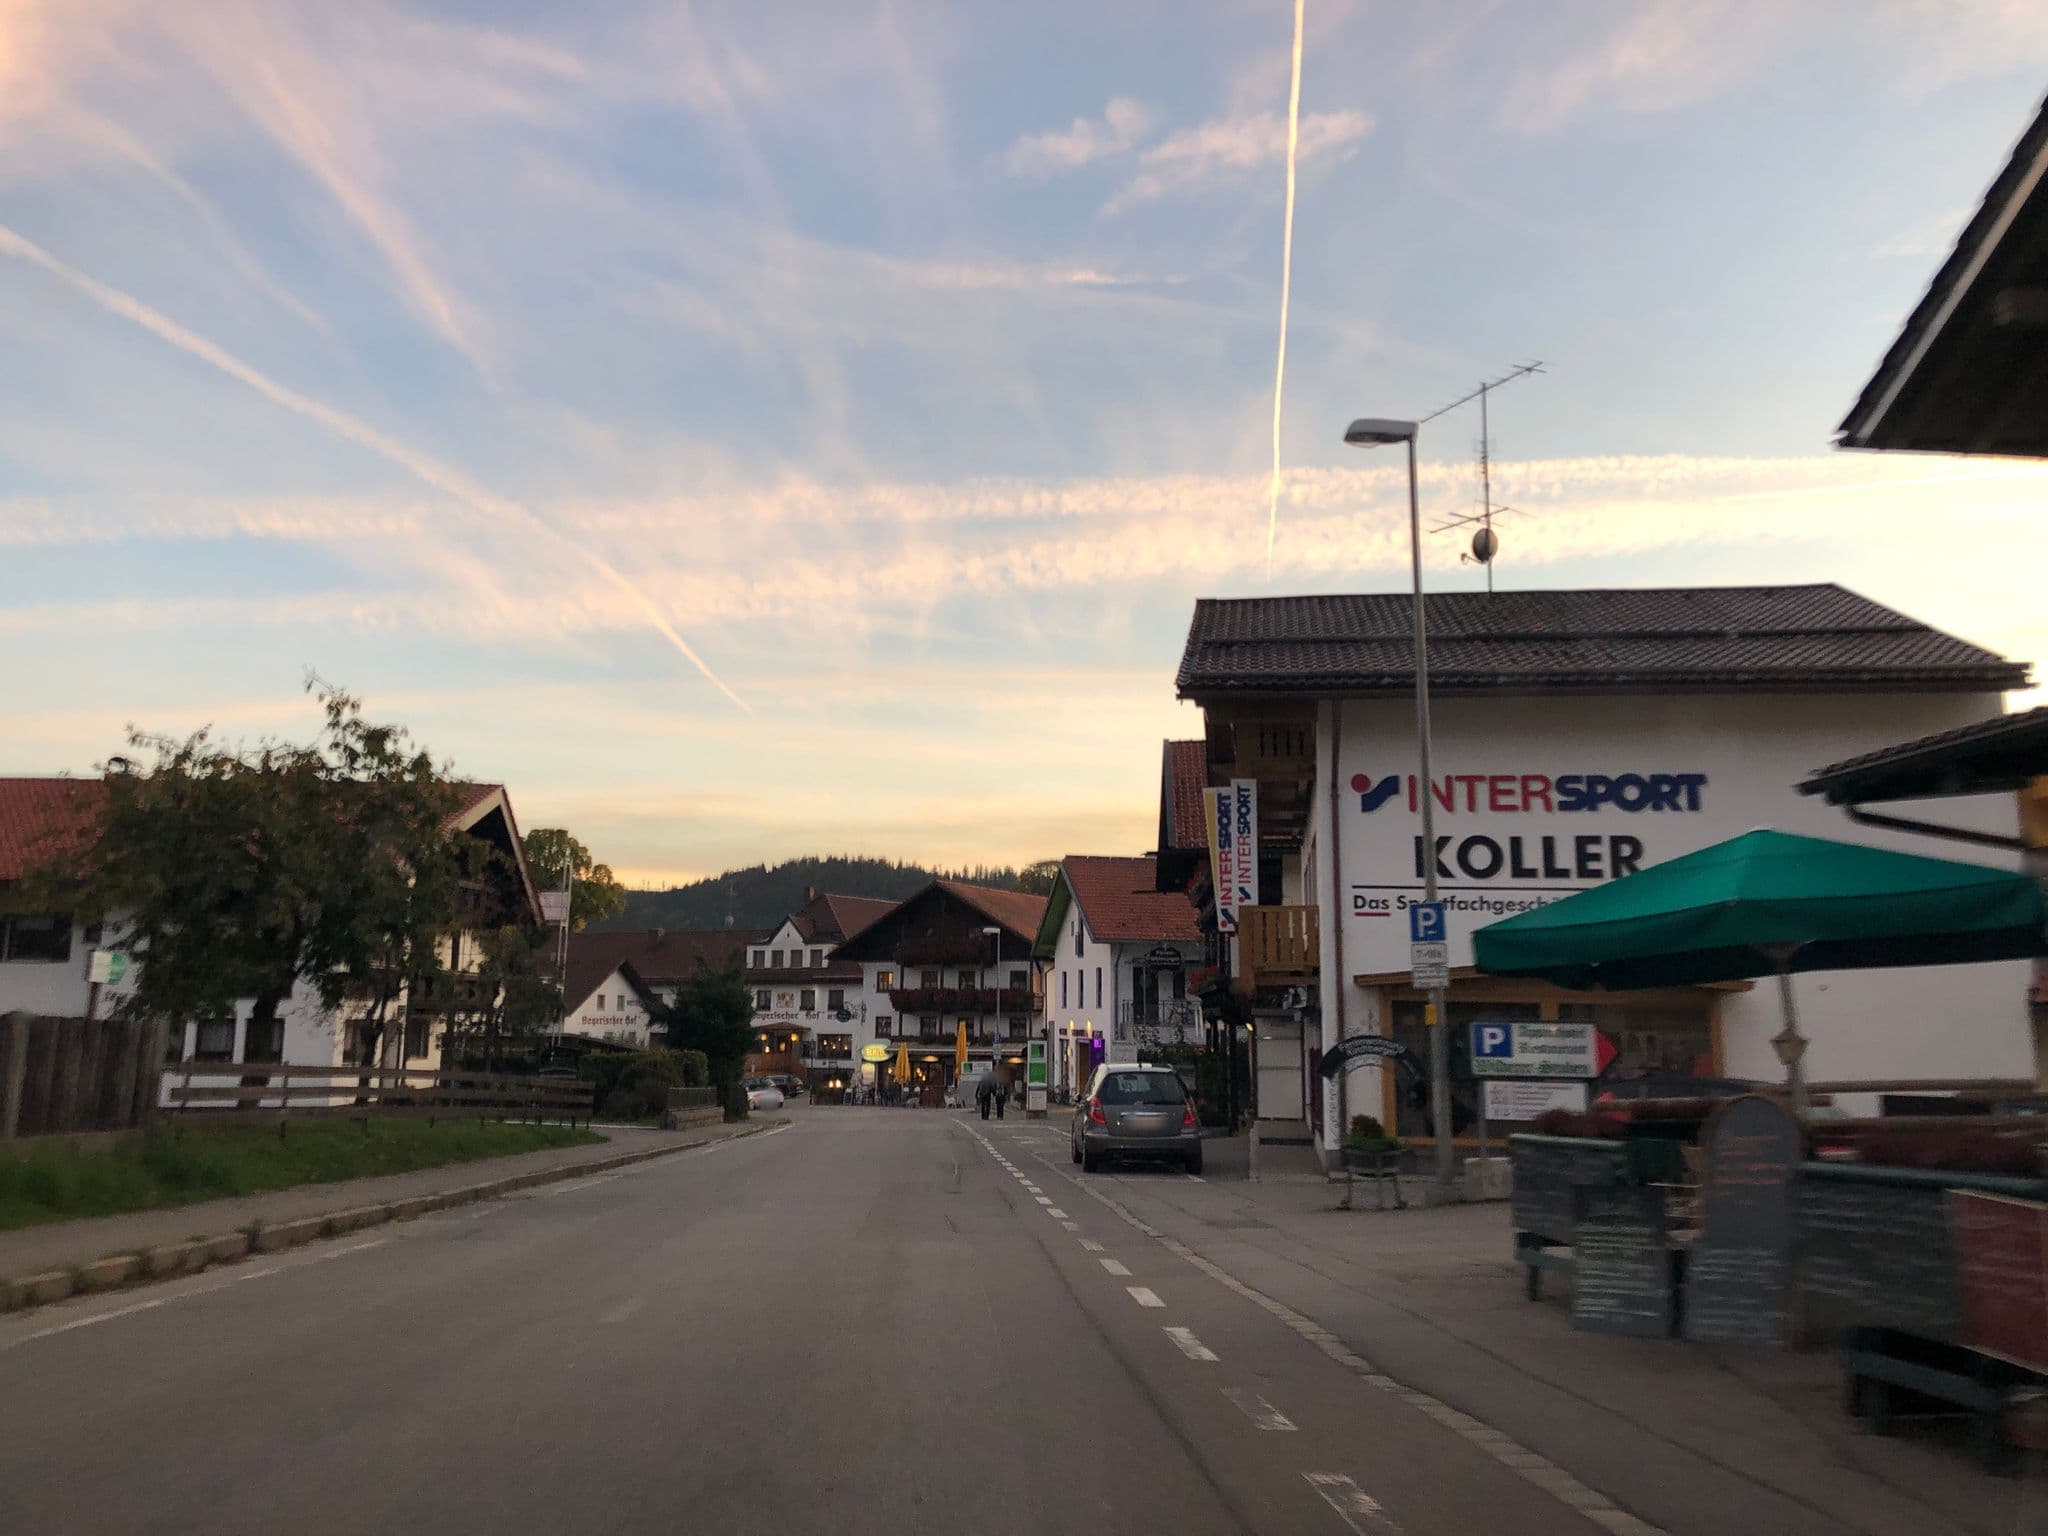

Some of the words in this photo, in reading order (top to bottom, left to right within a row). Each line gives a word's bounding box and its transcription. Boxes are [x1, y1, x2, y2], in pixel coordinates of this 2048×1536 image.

[1408, 773, 1707, 813] INTERSPORT
[1217, 793, 1232, 906] INTERSPORT
[1237, 784, 1251, 884] INTERSPORT
[1414, 835, 1644, 879] KOLLER
[1353, 894, 1390, 910] Das
[1418, 907, 1437, 938] P
[753, 1010, 799, 1021] ayerischer
[1482, 1026, 1506, 1054] P
